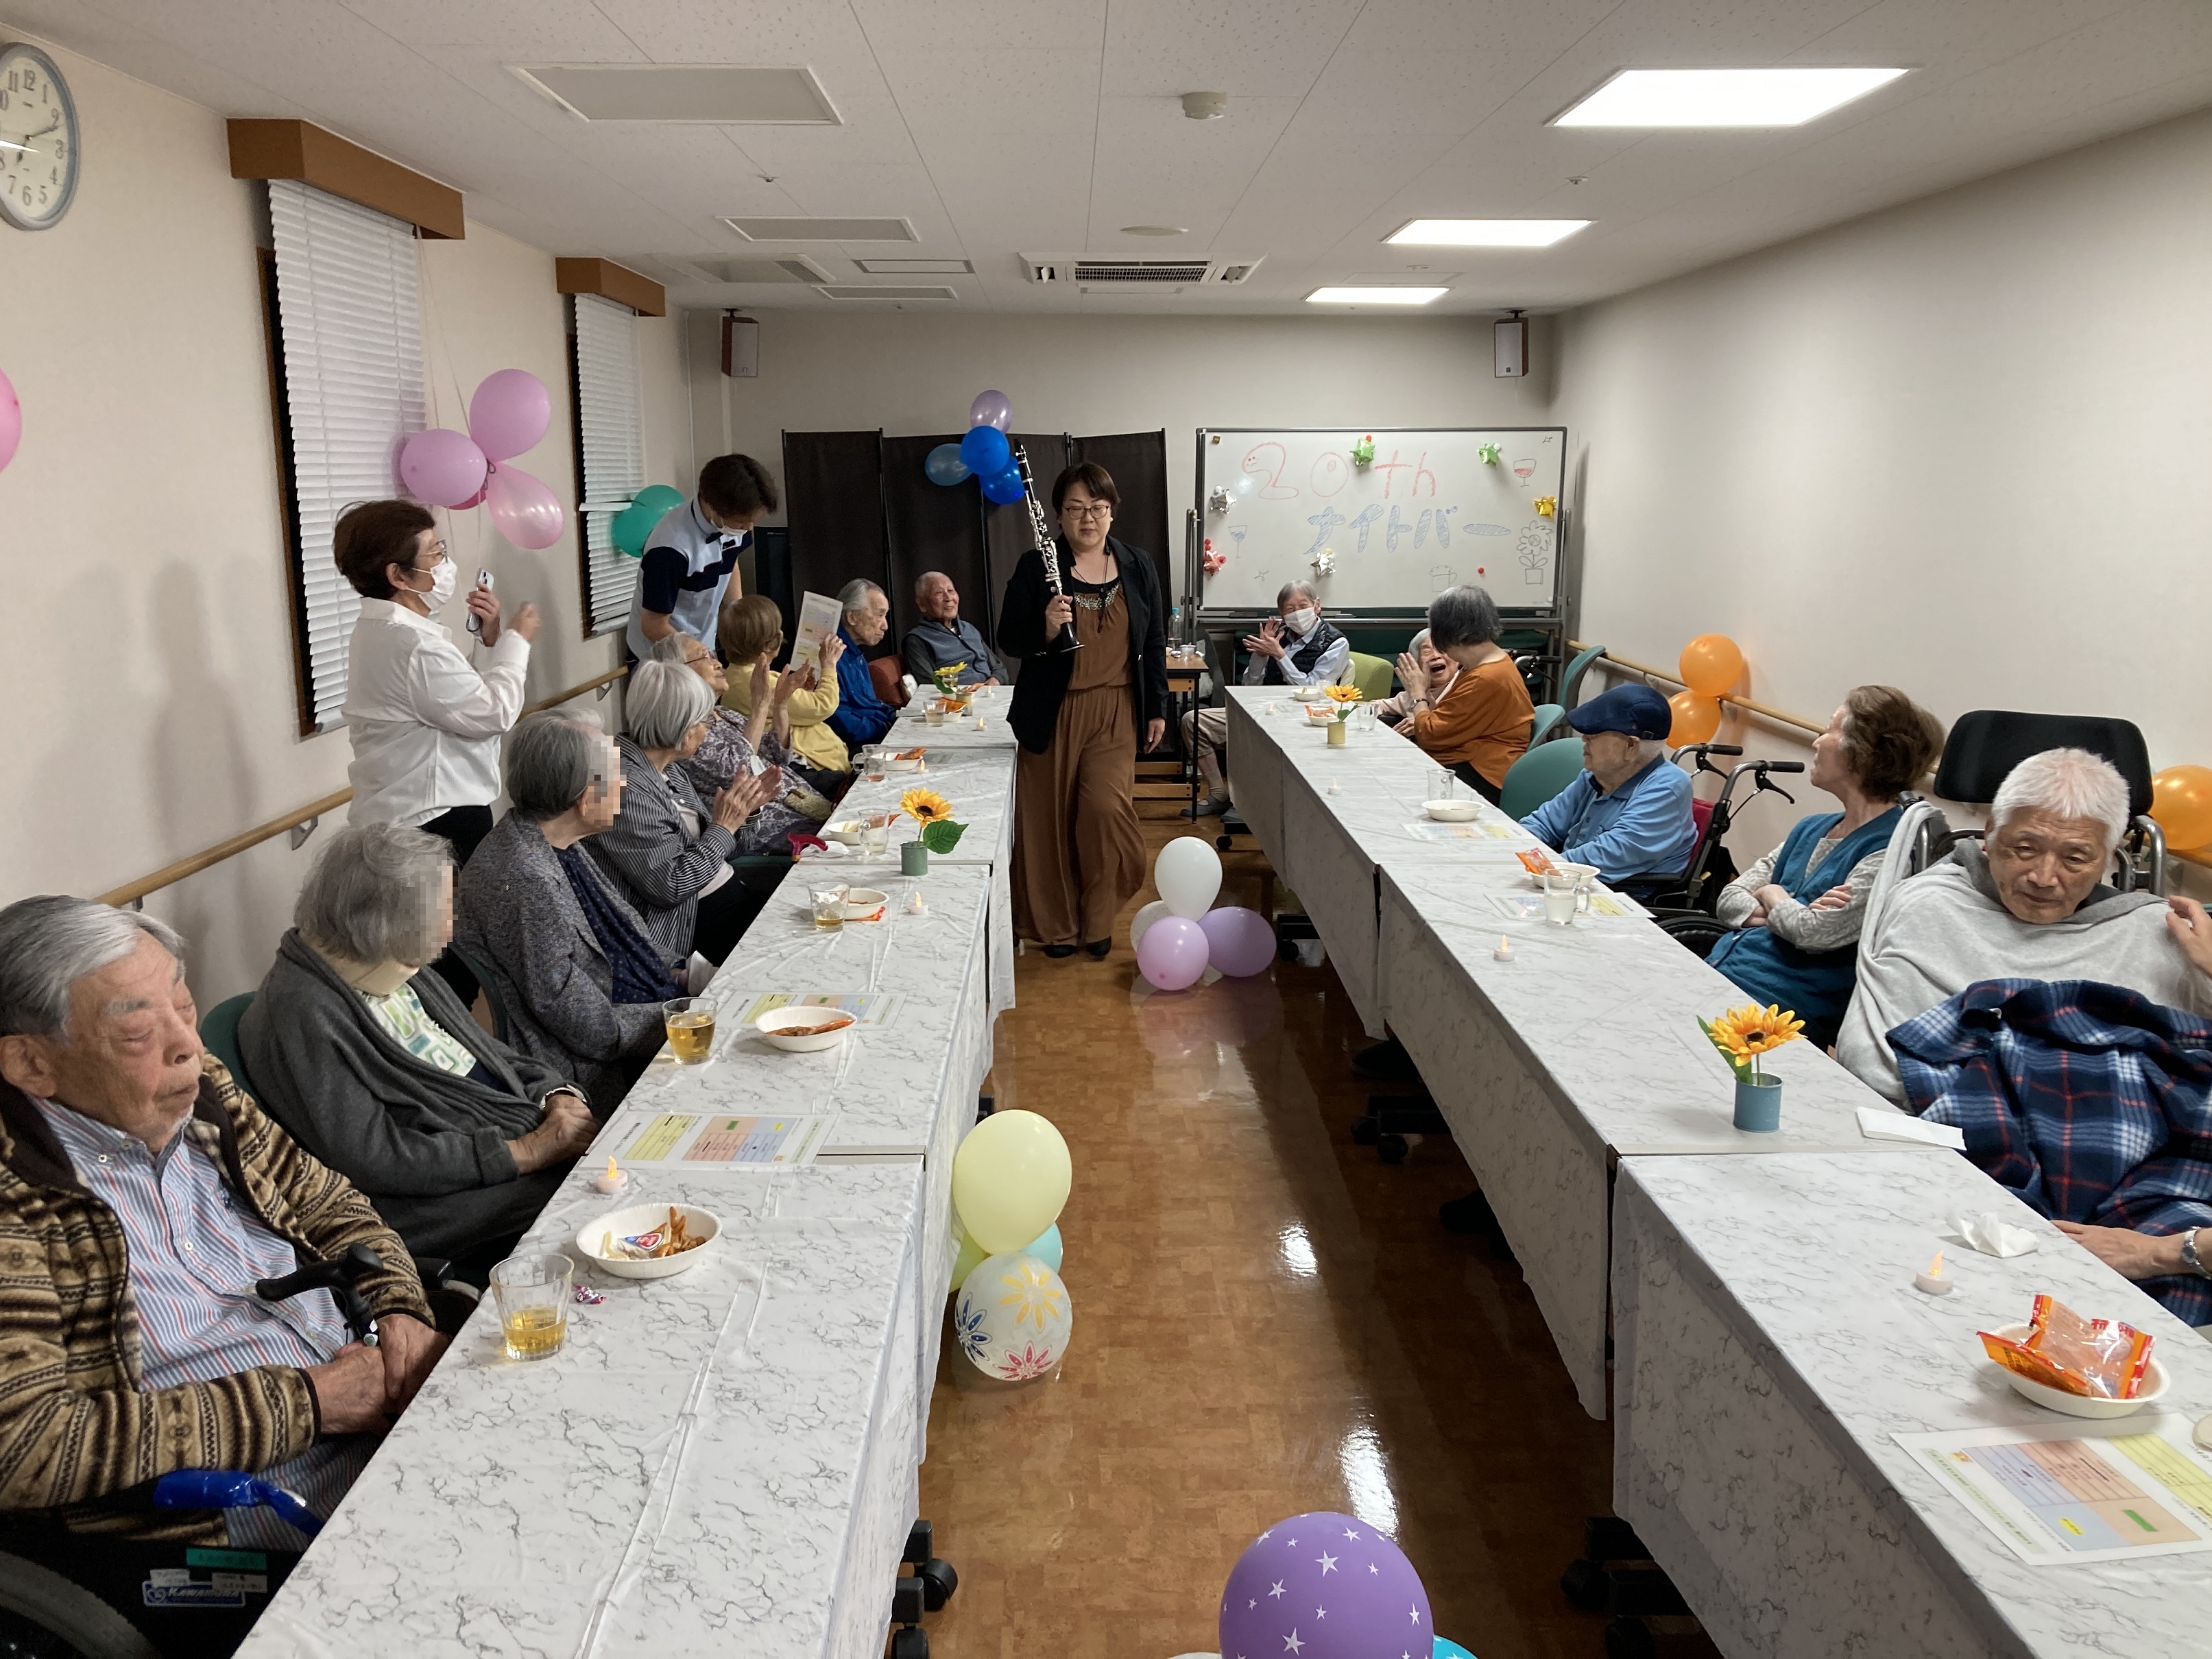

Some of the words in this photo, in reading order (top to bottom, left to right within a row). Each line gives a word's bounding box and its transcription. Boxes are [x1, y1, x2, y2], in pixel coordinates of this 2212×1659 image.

[8, 71, 19, 93] 11
[24, 69, 36, 91] 12
[0, 89, 9, 110] 0
[43, 84, 47, 104] 1
[56, 139, 64, 159] 3
[8, 175, 16, 194] 7
[49, 166, 58, 185] 4
[22, 185, 32, 206] 6
[38, 184, 47, 204] 5
[1303, 504, 1511, 554] ナイトバー
